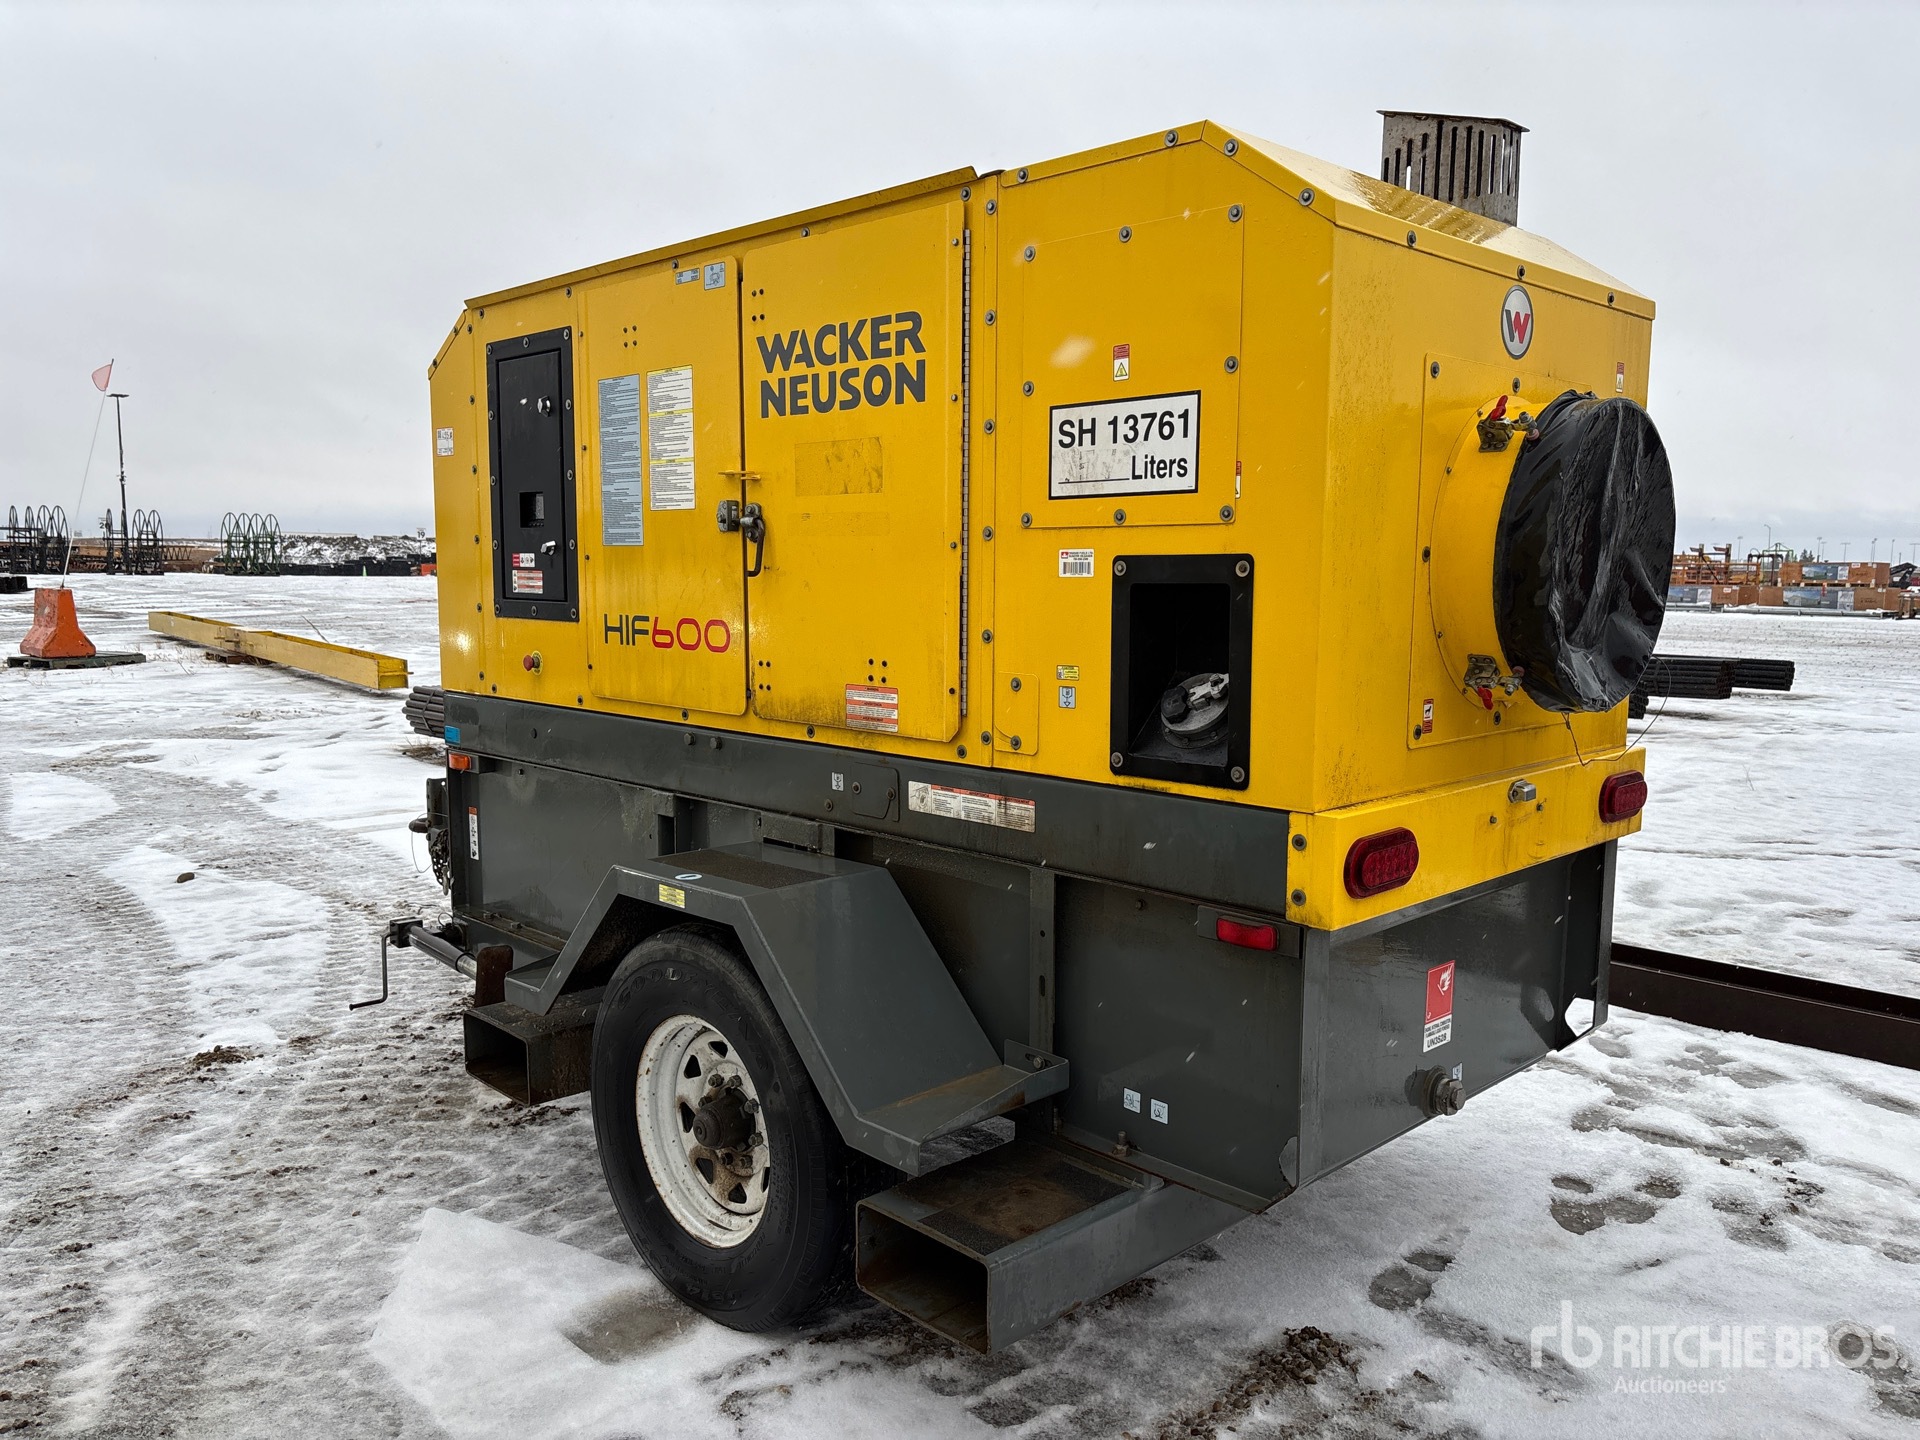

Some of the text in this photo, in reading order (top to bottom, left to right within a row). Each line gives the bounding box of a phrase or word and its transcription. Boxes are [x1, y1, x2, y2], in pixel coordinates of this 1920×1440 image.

[756, 311, 927, 373] WACKER
[760, 359, 926, 419] NEUSON
[1058, 408, 1190, 449] SH 13761
[1131, 454, 1188, 481] Liters
[603, 613, 731, 653] HIF600
